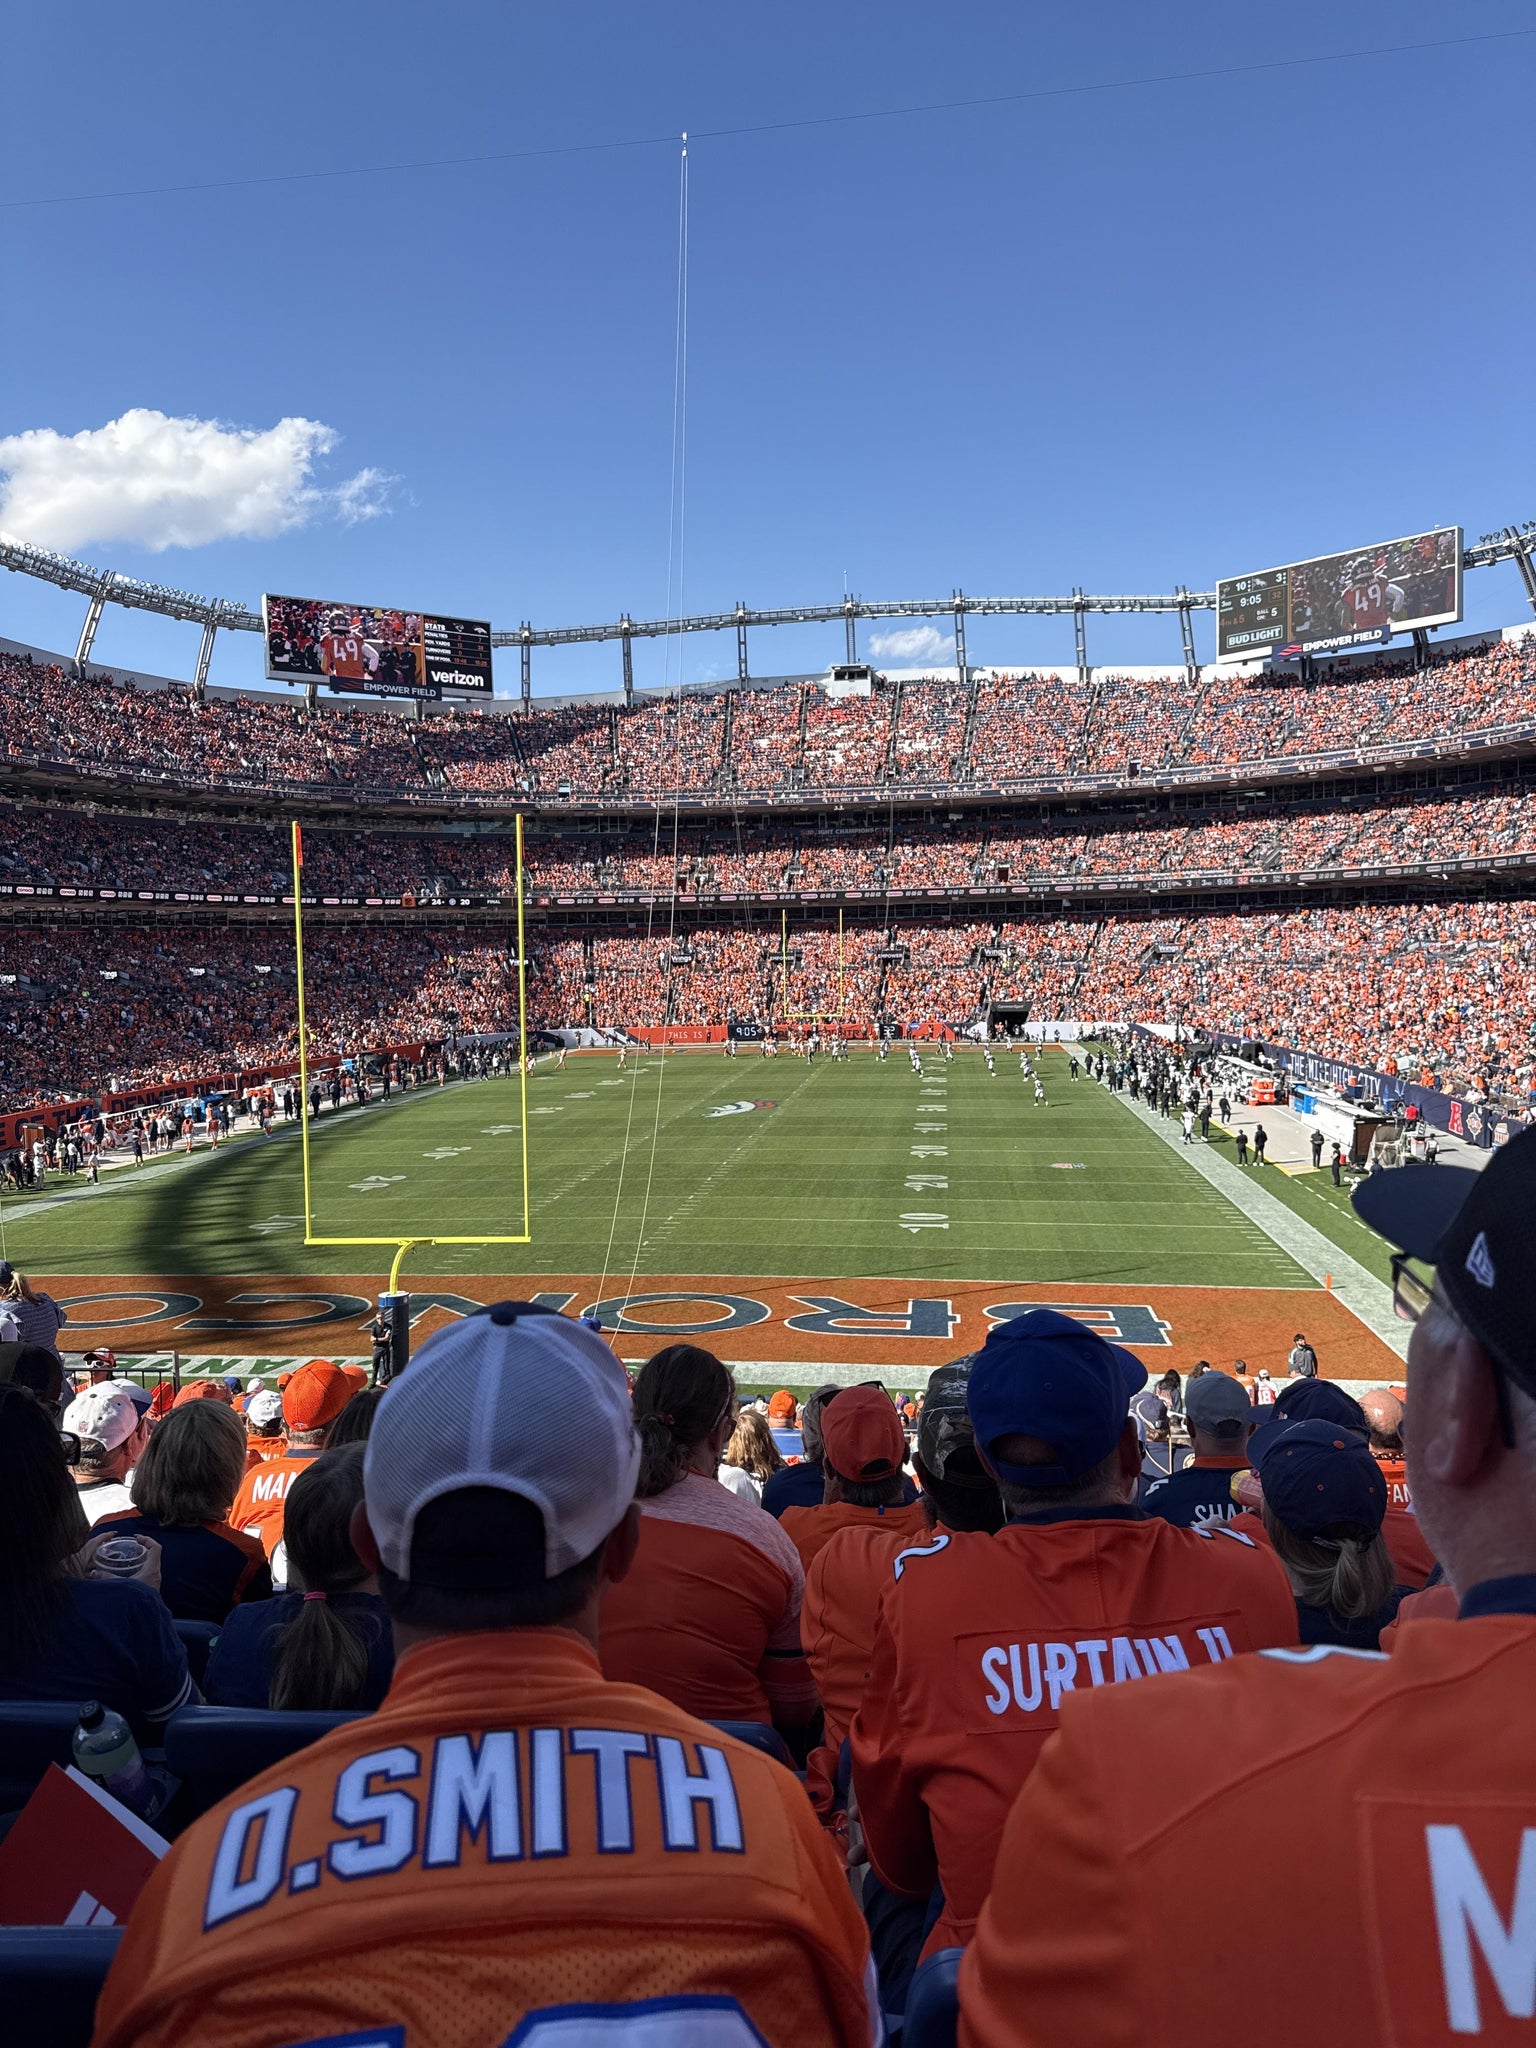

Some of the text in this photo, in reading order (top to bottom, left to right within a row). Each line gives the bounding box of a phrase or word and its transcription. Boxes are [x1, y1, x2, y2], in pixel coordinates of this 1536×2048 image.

[1275, 573, 1283, 584] 3
[1235, 581, 1247, 592] 10
[1239, 594, 1262, 608] 9:05
[1271, 591, 1282, 600] 32
[1354, 583, 1382, 612] 49
[1256, 608, 1269, 616] BALL
[1270, 607, 1278, 617] 5
[425, 623, 446, 632] STATS
[1228, 628, 1281, 646] BUD LIGHT
[1302, 629, 1383, 652] EMPOWER FIELD
[333, 639, 359, 662] 49
[430, 670, 485, 687] verizon
[363, 683, 437, 698] EMPOWER FIELD
[1505, 733, 1521, 742] SMITH
[1448, 744, 1463, 752] DAVIS
[12, 757, 38, 766] FLETCHER
[1374, 753, 1411, 762] ZIMMERMAN
[90, 769, 118, 779] UPCHURCH
[1251, 769, 1279, 777] JACKSON
[835, 828, 875, 836] CHAMPIONS
[1156, 880, 1167, 888] 10
[1216, 877, 1234, 885] 9:05
[1237, 876, 1249, 885] 32
[1285, 874, 1291, 882] 5
[1158, 944, 1179, 953] Wings
[671, 955, 692, 963] Wings
[668, 1031, 703, 1039] THIS IS
[1289, 1053, 1305, 1077] THE
[1357, 1071, 1382, 1097] CITY
[111, 1071, 272, 1111] DENVER BRONCOS
[422, 1146, 473, 1158] 30
[910, 1144, 949, 1156] 30
[347, 1174, 407, 1190] 20
[903, 1174, 949, 1189] 20
[248, 1213, 317, 1232] 10
[898, 1212, 950, 1229] 10
[66, 1290, 1172, 1346] BRONCO
[894, 1534, 952, 1584] 2
[981, 1634, 1191, 1716] SURTAIN
[204, 1727, 745, 1932] D.SMITH
